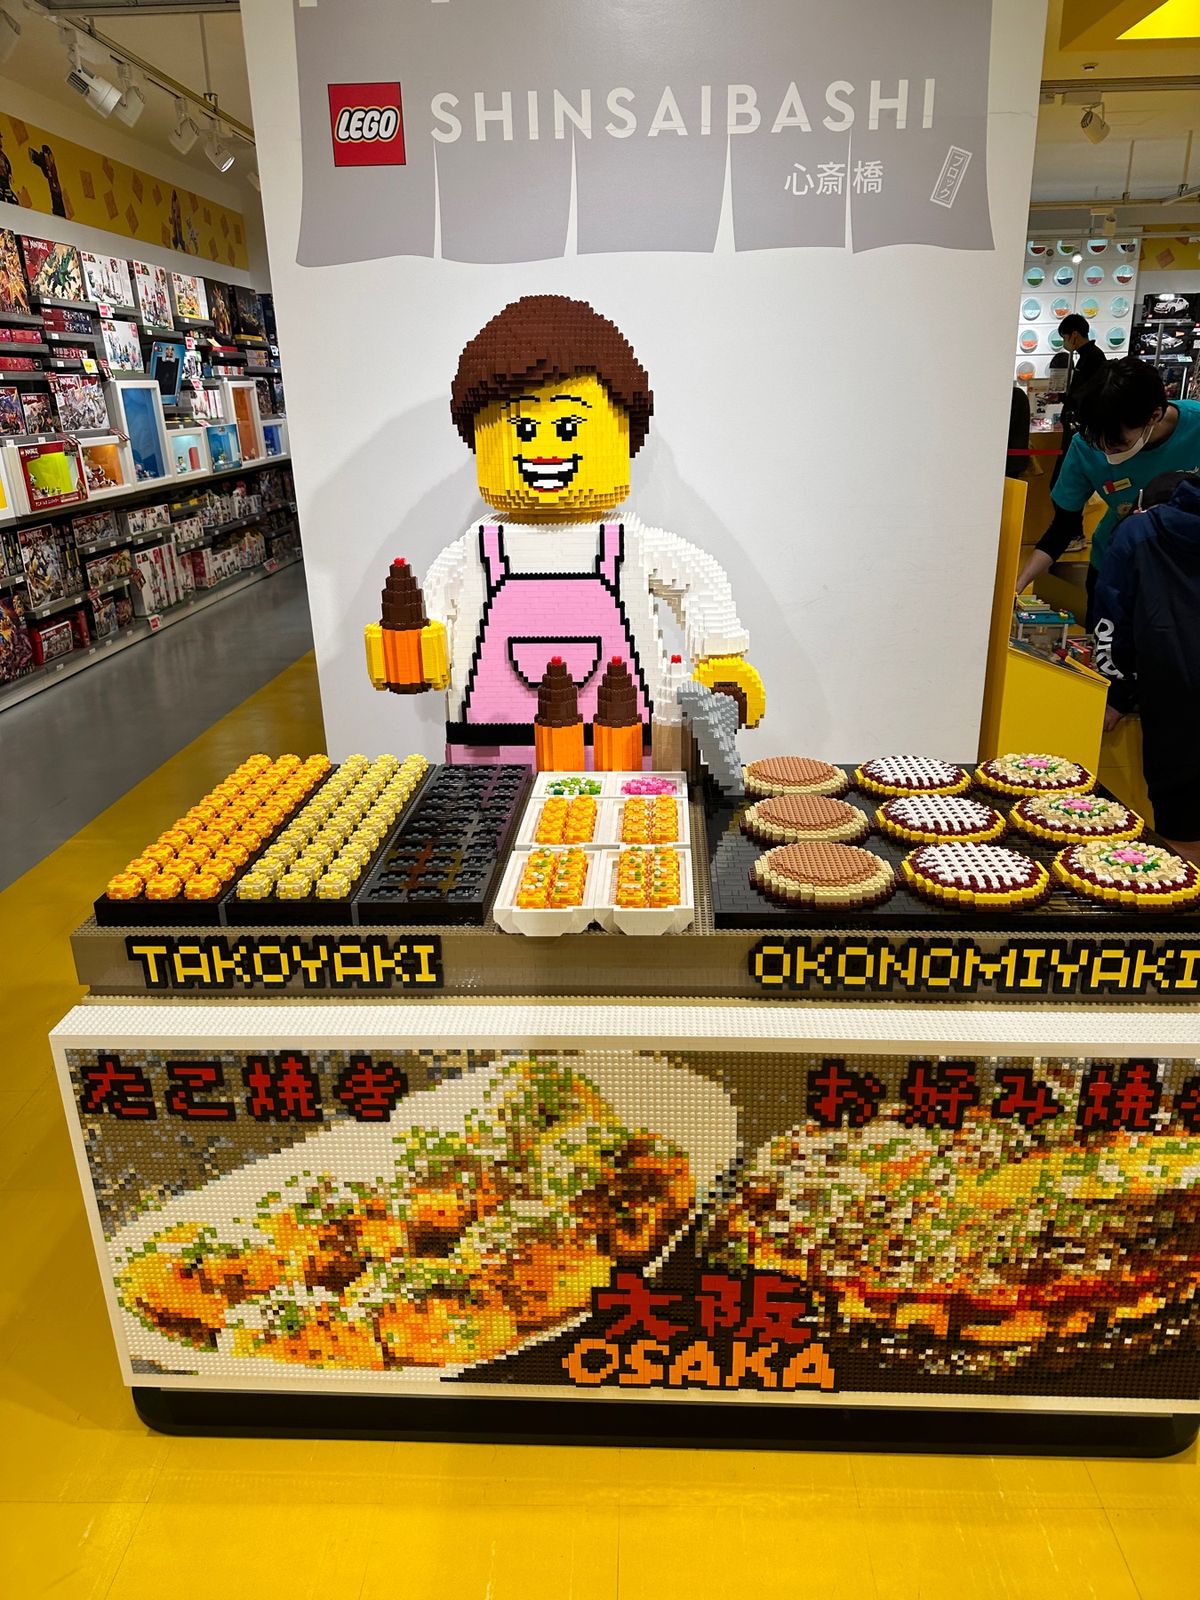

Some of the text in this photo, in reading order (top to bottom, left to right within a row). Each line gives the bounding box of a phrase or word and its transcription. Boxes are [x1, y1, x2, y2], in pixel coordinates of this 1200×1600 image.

[336, 108, 399, 141] LEGO
[430, 78, 936, 143] SHINSAIBASHI
[784, 160, 884, 195] 心斎橋
[130, 942, 439, 985] TAKOYAKI
[753, 944, 1200, 989] OKONOMIYAKI
[86, 1056, 403, 1118] たこ焼き
[595, 1273, 813, 1344] 大阪
[560, 1338, 835, 1389] OSAKA
